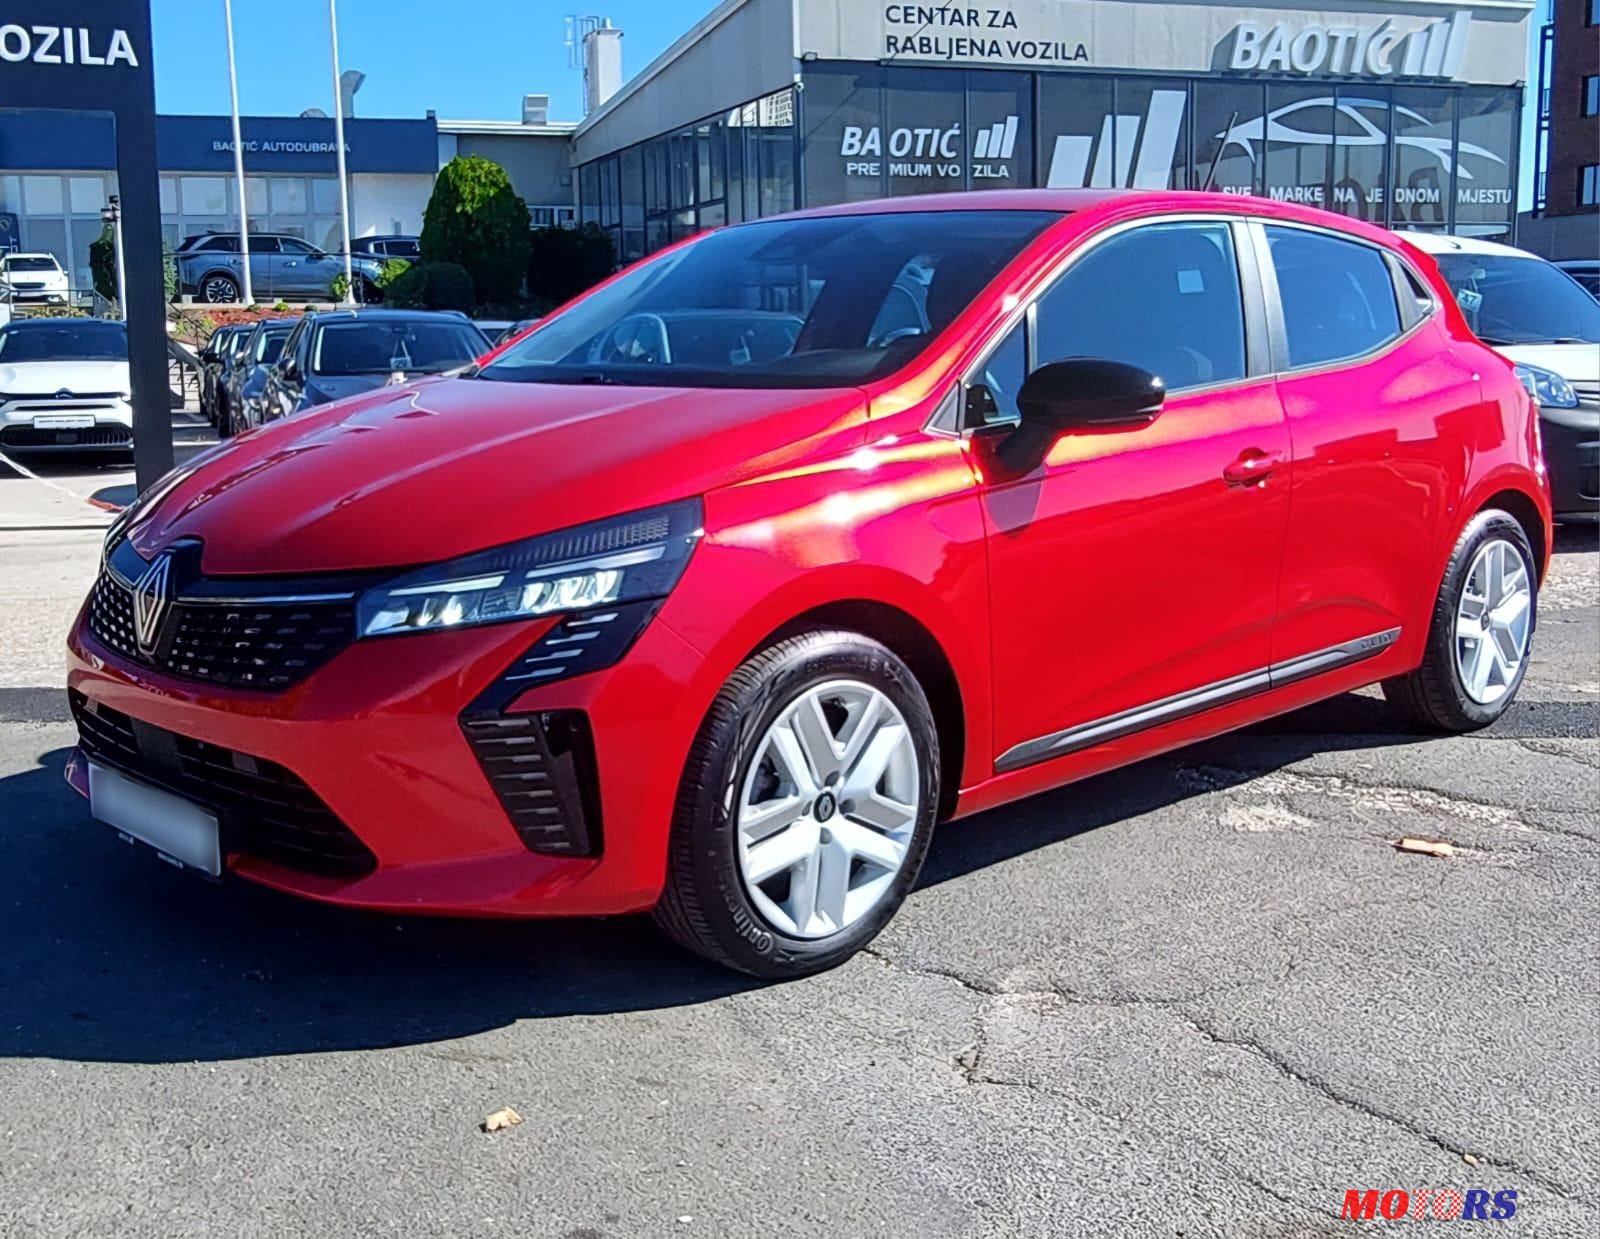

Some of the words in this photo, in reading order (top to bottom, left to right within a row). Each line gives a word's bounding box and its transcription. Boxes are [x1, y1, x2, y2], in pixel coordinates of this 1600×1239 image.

[885, 5, 980, 27] CENTAR
[987, 10, 1018, 29] ZA
[886, 35, 1003, 60] RABLJENA
[1006, 40, 1089, 62] VOZILA
[1229, 18, 1396, 76] BAOTIĆ
[1270, 186, 1323, 201] MARKE
[1334, 187, 1356, 202] NA
[1457, 189, 1512, 203] MJESTU
